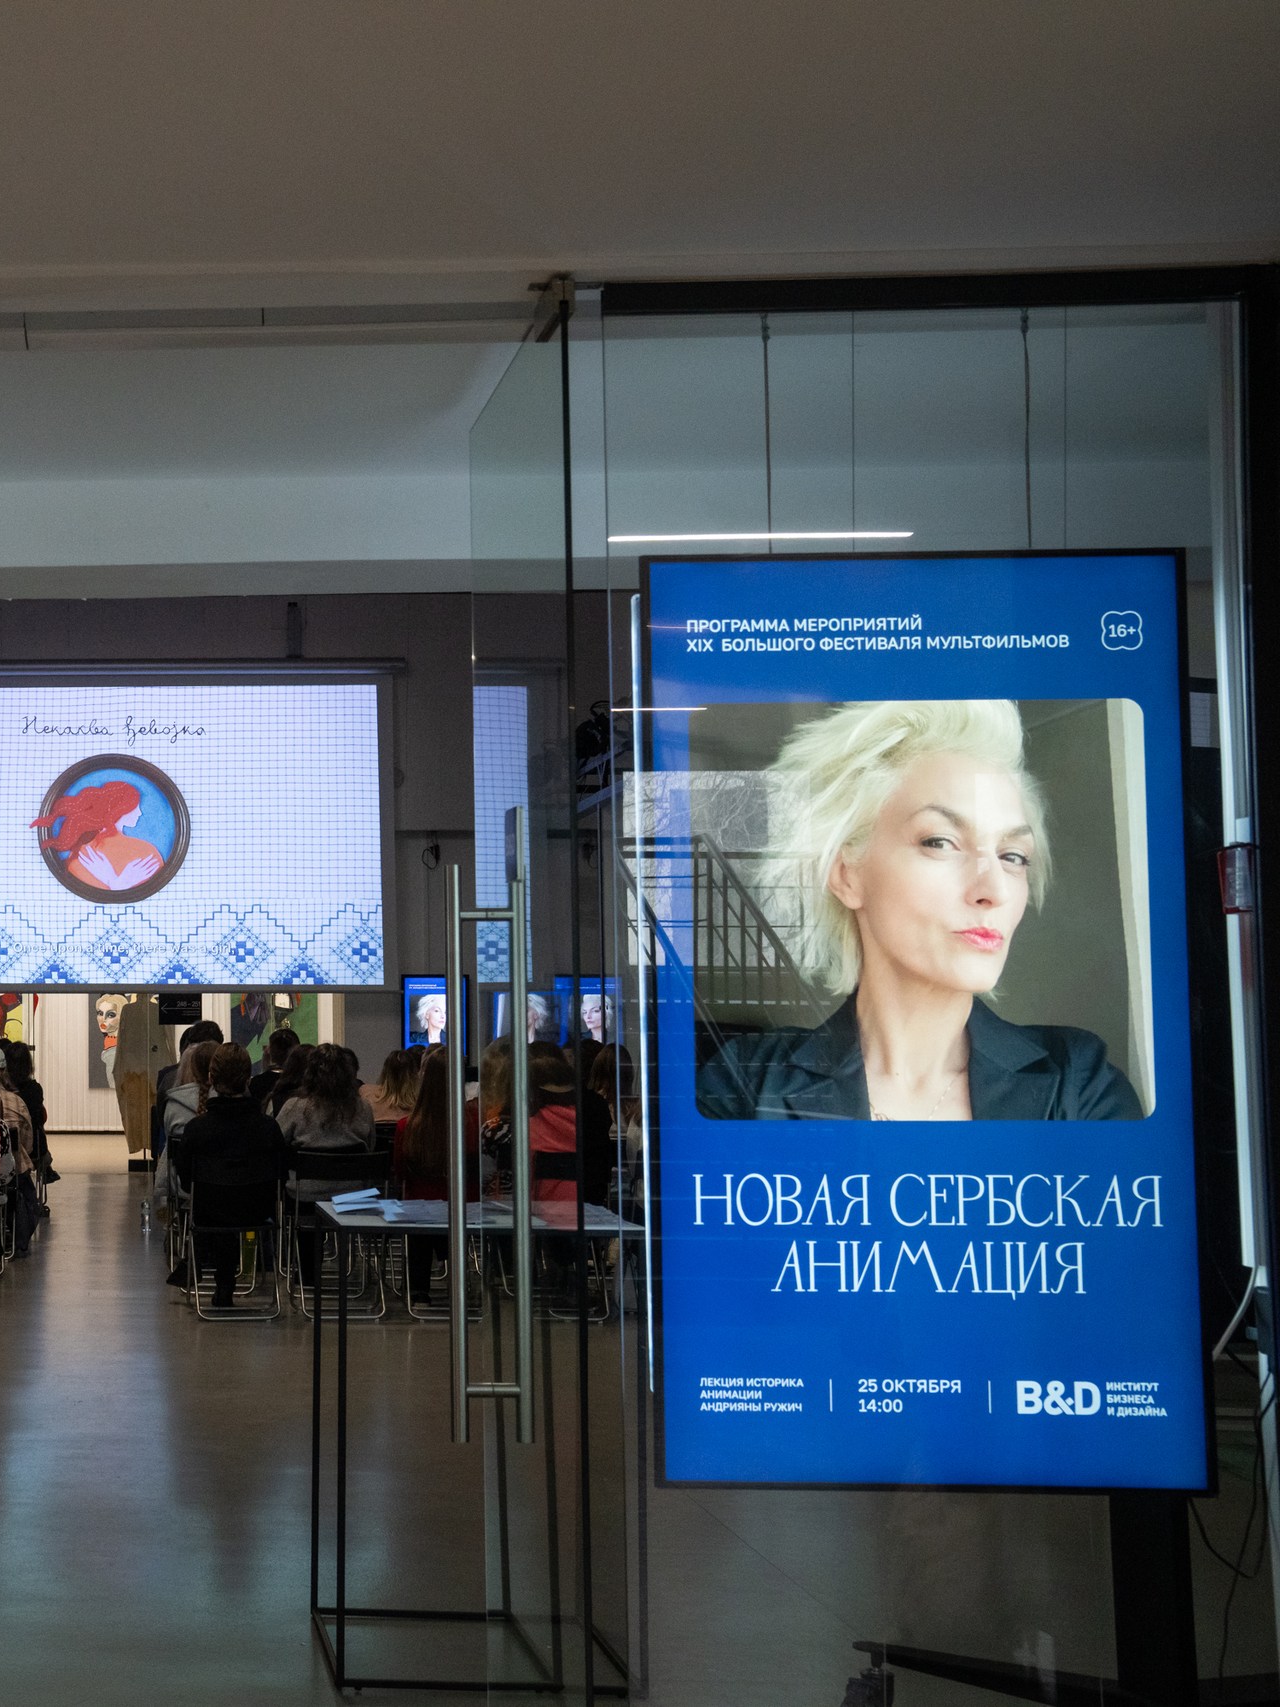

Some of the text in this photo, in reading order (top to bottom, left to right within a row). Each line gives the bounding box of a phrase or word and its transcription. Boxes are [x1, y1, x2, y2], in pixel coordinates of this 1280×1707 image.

[686, 613, 922, 633] ПРОГРАММА МЕРОПРИЯТИЙ
[1108, 623, 1137, 638] 16+
[686, 634, 1070, 653] XIX БОЛЬШОГО ФЕСТИВАЛЯ МУЛЬТФИЛЬМОВ
[13, 942, 48, 954] Once
[50, 944, 85, 957] upon
[98, 942, 130, 956] time,
[132, 942, 166, 954] there
[169, 945, 194, 954] was
[211, 942, 236, 957] girl,
[692, 1172, 1164, 1228] НОВАЯ СЕРБСКАЯ
[770, 1240, 1087, 1299] АНИМАЦИЯ
[699, 1377, 804, 1388] ЛЕКЦИЯ ИСТОРИКА
[858, 1378, 962, 1394] 25 ОКТЯБРЯ
[1105, 1381, 1160, 1392] ИНСТИТУТ
[700, 1389, 762, 1401] АНИМАЦИИ
[1016, 1380, 1101, 1416] B&D
[1106, 1394, 1155, 1404] БИЗНЕСА
[700, 1402, 803, 1413] АНДРИЯНЫ РУЖИЧ
[858, 1398, 903, 1413] 14:00
[1106, 1405, 1168, 1418] И ДИЗАЙНА
